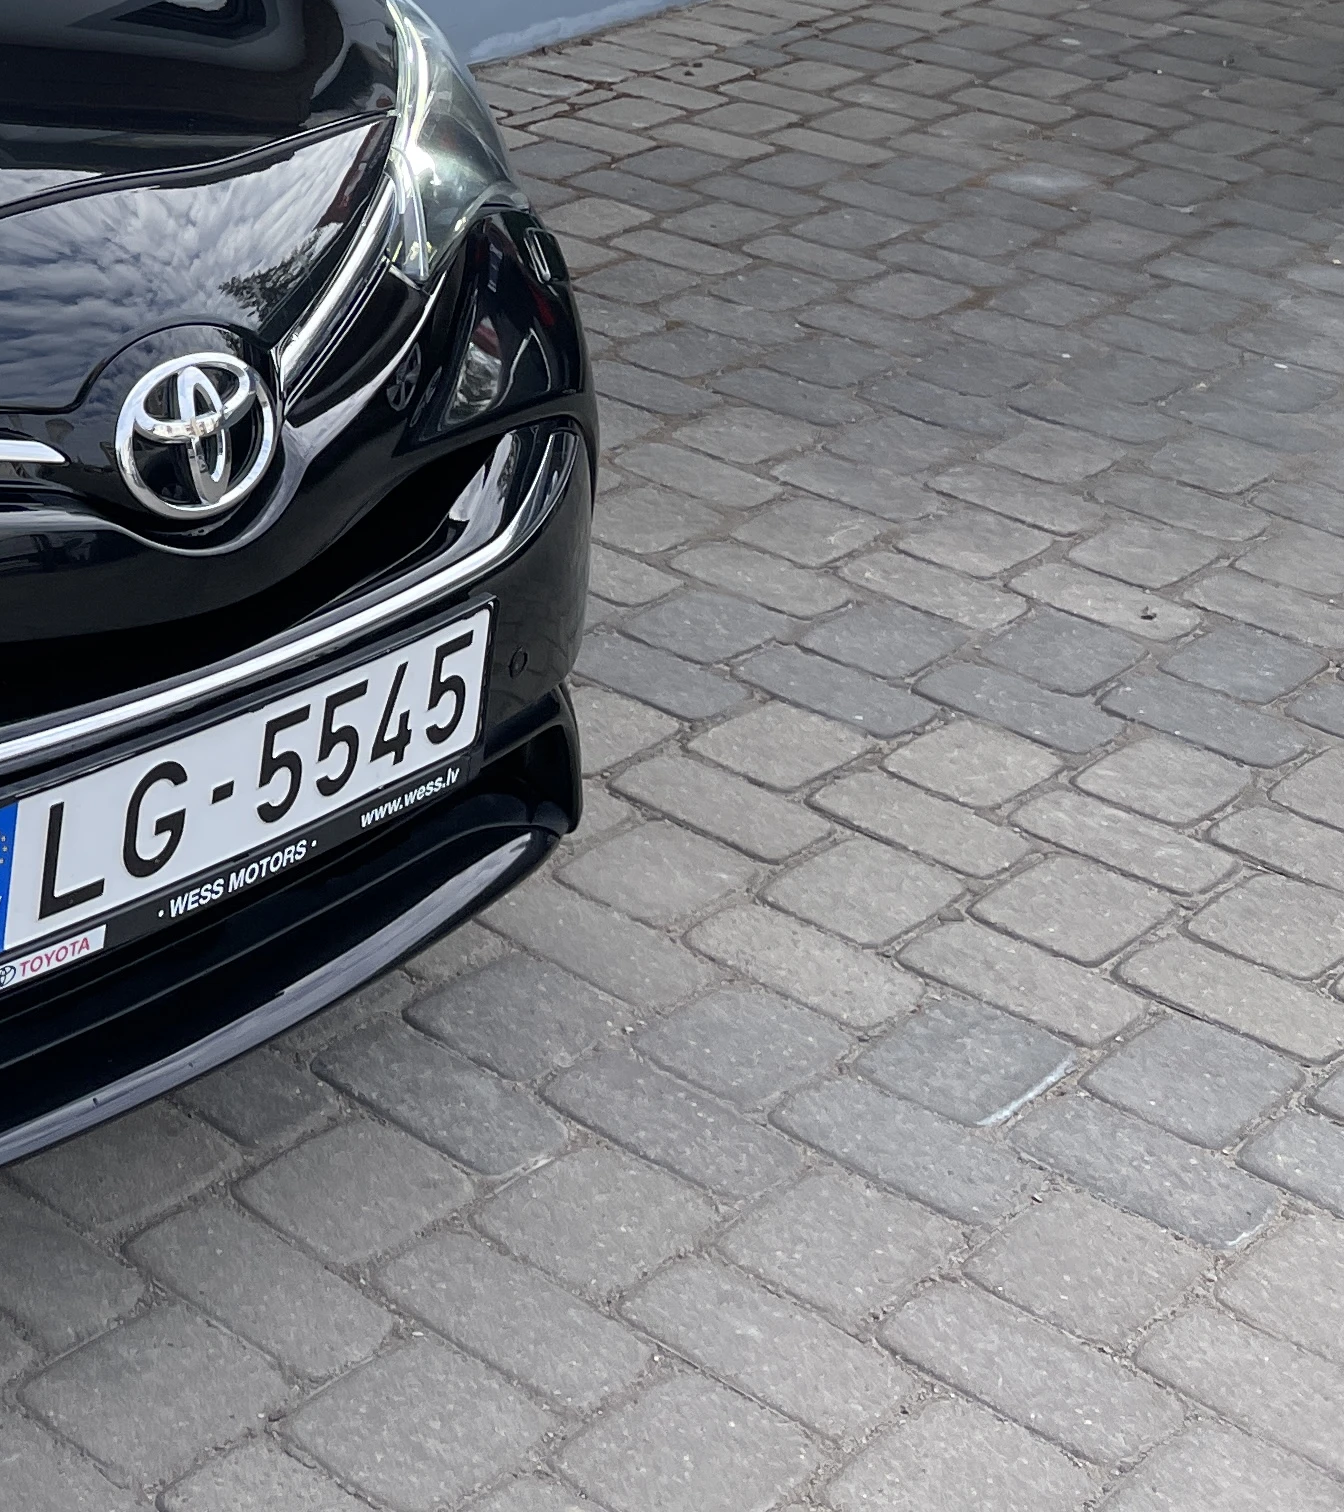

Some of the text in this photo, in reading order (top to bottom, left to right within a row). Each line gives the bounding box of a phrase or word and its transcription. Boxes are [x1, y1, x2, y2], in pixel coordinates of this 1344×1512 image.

[37, 629, 475, 921] LG-5545
[359, 766, 461, 829] www.wess.lv
[169, 838, 308, 918] WESS MOTORS
[19, 936, 90, 978] TOYOTA
